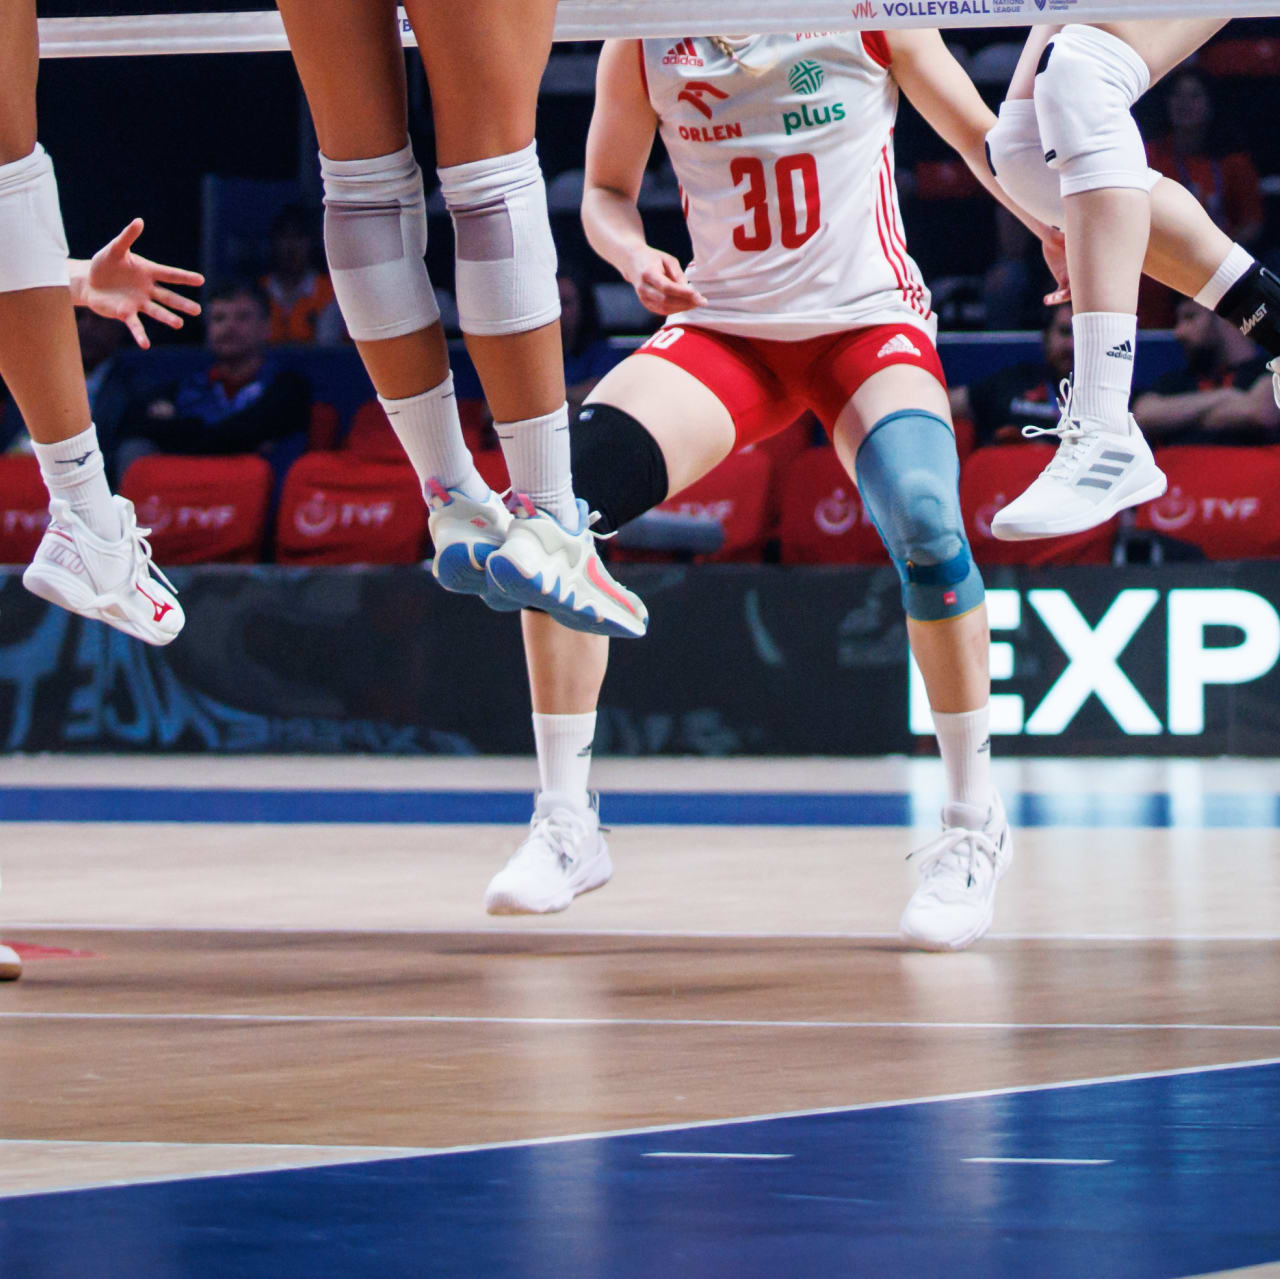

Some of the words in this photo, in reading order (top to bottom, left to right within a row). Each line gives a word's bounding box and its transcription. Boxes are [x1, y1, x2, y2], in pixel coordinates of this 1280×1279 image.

[882, 0, 991, 17] VOLLEYBALL
[662, 53, 704, 67] adidas
[782, 102, 846, 136] plus
[678, 122, 744, 143] ORLEN
[730, 152, 821, 252] 30
[340, 500, 396, 528] TVF
[1199, 497, 1261, 522] TVF
